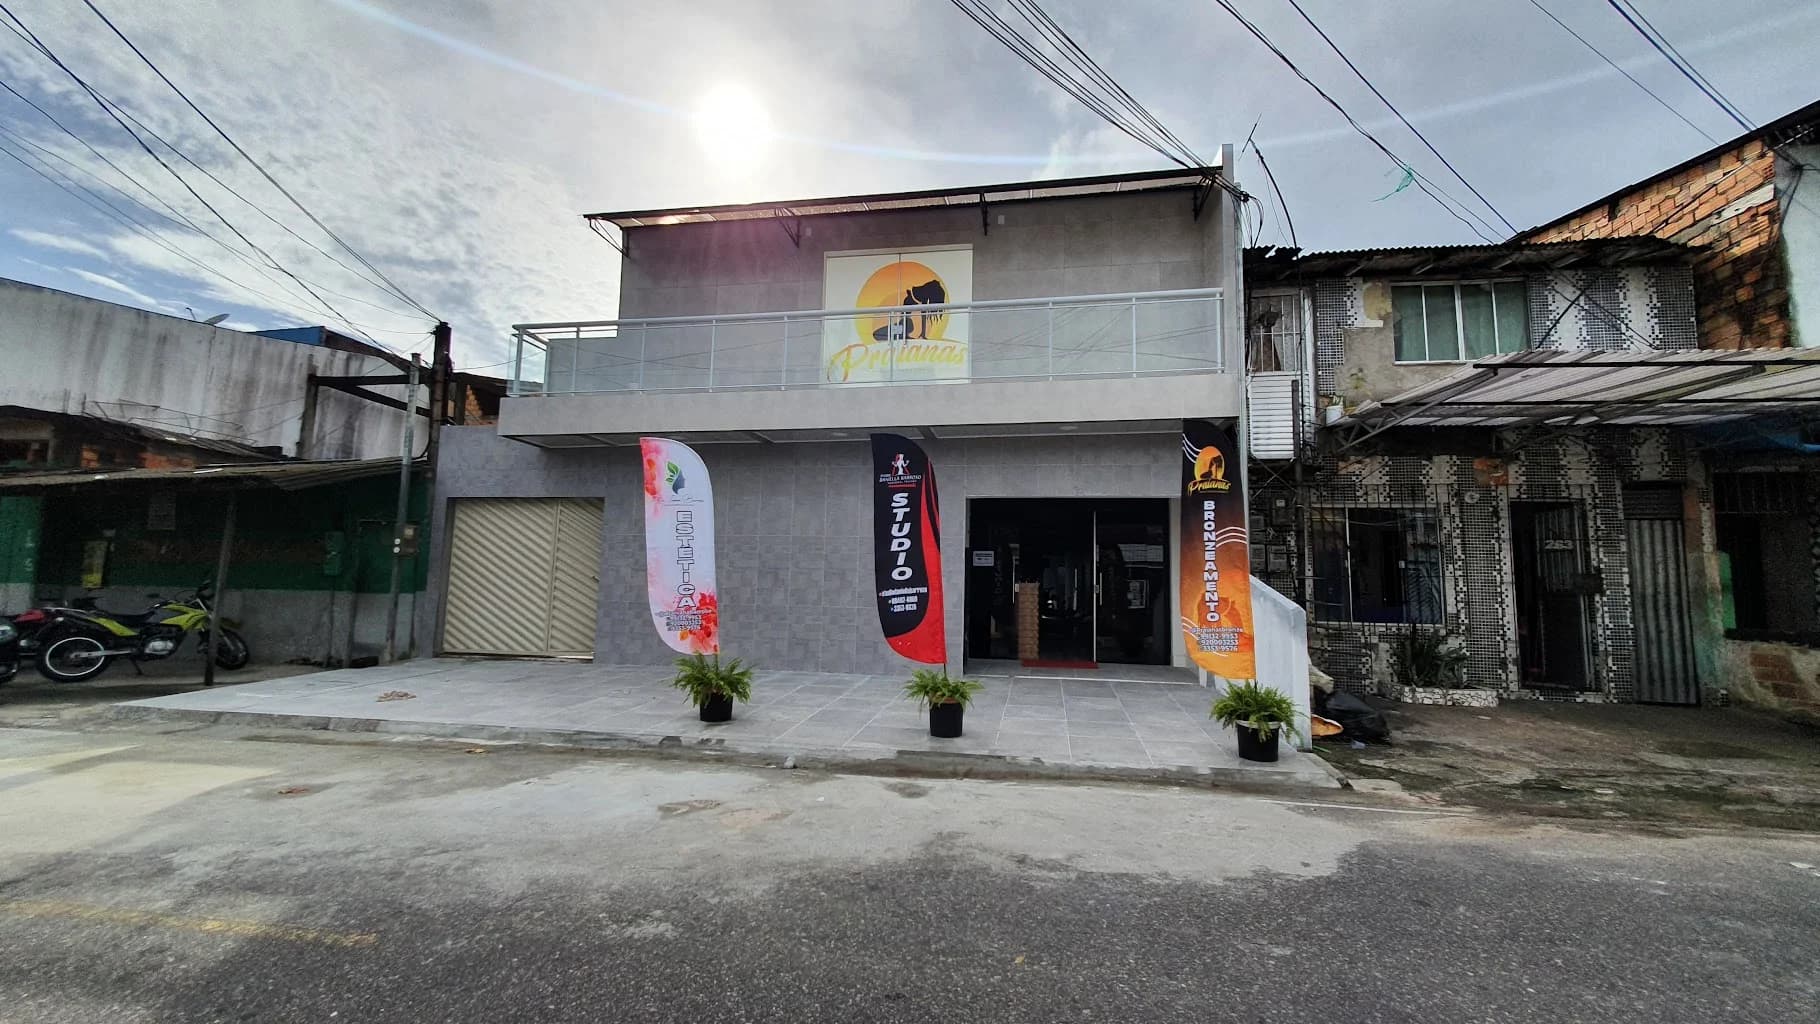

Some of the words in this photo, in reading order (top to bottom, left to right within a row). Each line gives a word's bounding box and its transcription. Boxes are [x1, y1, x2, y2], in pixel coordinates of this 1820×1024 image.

[1187, 480, 1232, 496] Praianas
[890, 492, 913, 581] STUDIO
[1203, 500, 1220, 622] BRONZEAMENTO
